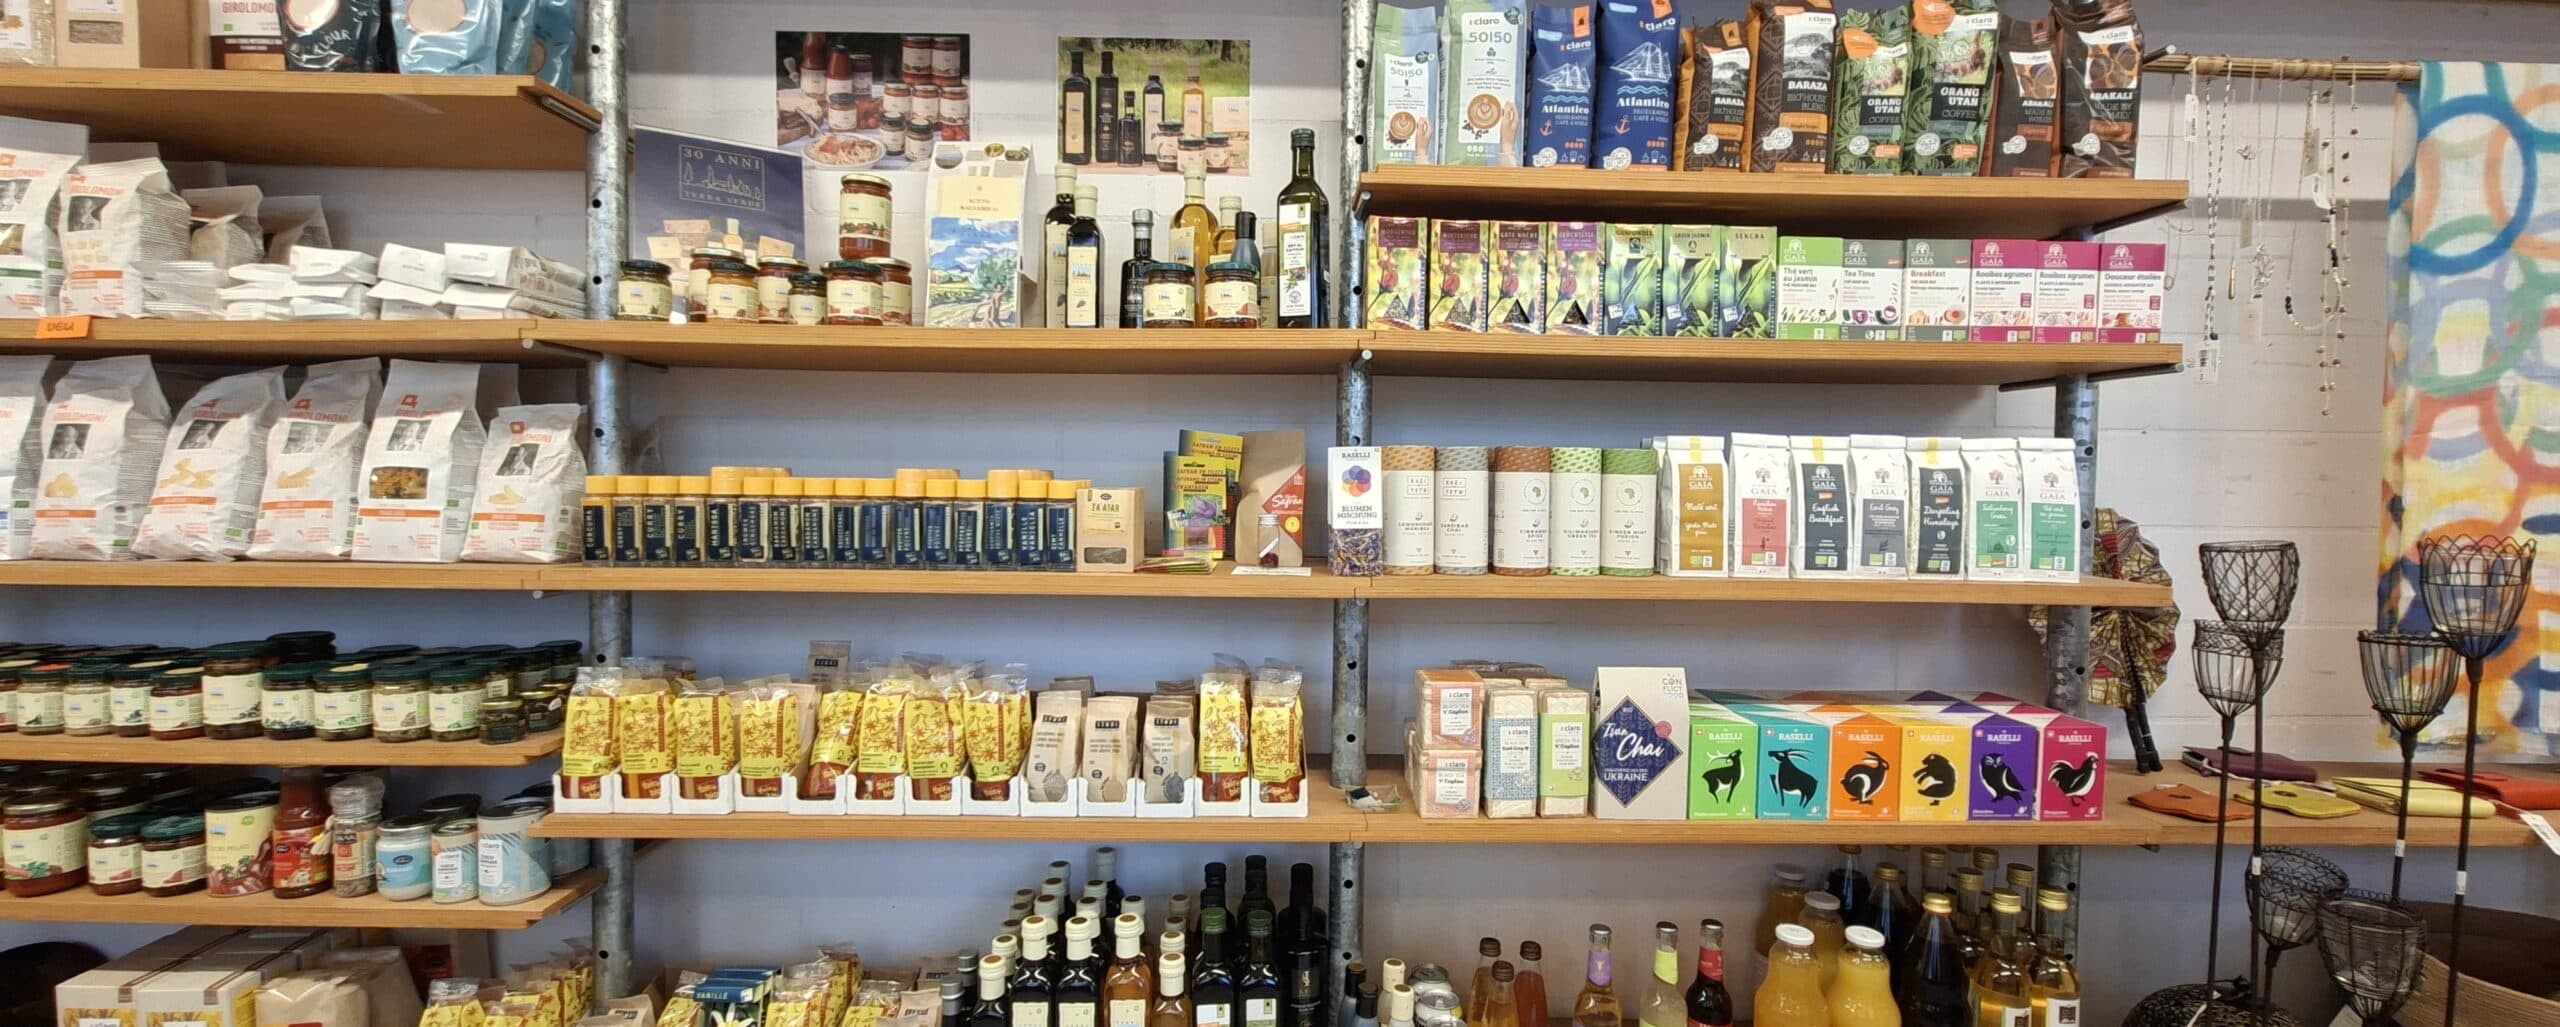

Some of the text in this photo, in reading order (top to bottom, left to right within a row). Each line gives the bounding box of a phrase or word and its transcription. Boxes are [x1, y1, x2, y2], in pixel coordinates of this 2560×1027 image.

[1566, 40, 1591, 50] claro
[1788, 81, 1827, 91] BARAZA
[1941, 87, 1979, 97] ORANG
[1617, 97, 1669, 109] Atlantico
[1948, 97, 1979, 107] UTAN
[1542, 105, 1589, 114] Atlantico
[683, 149, 761, 169] 30 ANNI
[1794, 275, 1817, 283] jasmin
[2105, 273, 2135, 281] Douceur
[1812, 503, 1840, 515] English
[1885, 505, 1899, 514] Grey
[1809, 514, 1844, 526] Breakfast
[1708, 733, 1742, 741] RASELLI
[1778, 733, 1813, 741] RASELLI
[1848, 734, 1884, 742] RASELLI
[1987, 734, 2021, 742] RASELLI
[2058, 734, 2092, 742] RASELLI
[1616, 732, 1664, 761] Chai
[1604, 773, 1648, 781] UKRAINE
[696, 992, 728, 1000] VANILLE
